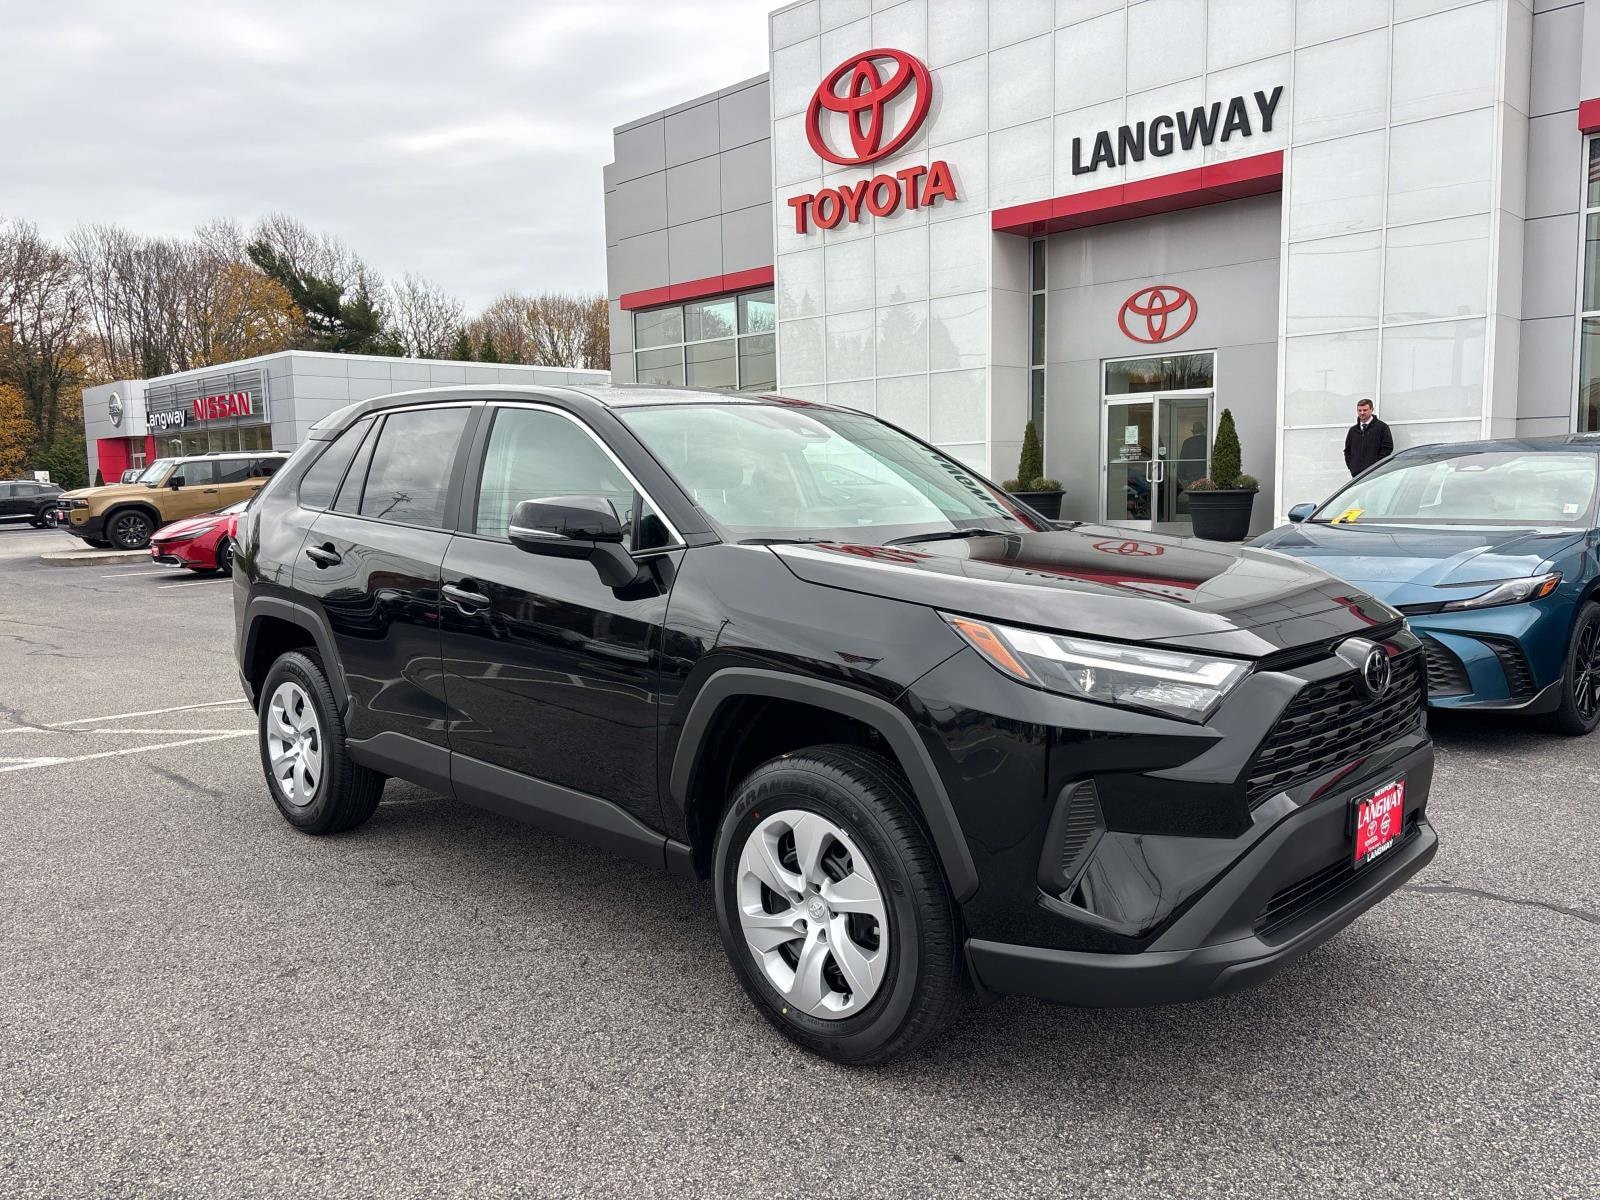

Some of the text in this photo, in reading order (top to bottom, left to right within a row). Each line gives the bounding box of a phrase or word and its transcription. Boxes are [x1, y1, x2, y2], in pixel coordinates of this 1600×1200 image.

[1072, 85, 1283, 175] LANGWAY
[788, 160, 957, 235] TOYOTA
[146, 409, 187, 430] Langway
[193, 391, 252, 421] NISSAN
[1358, 788, 1402, 829] LANGWAY
